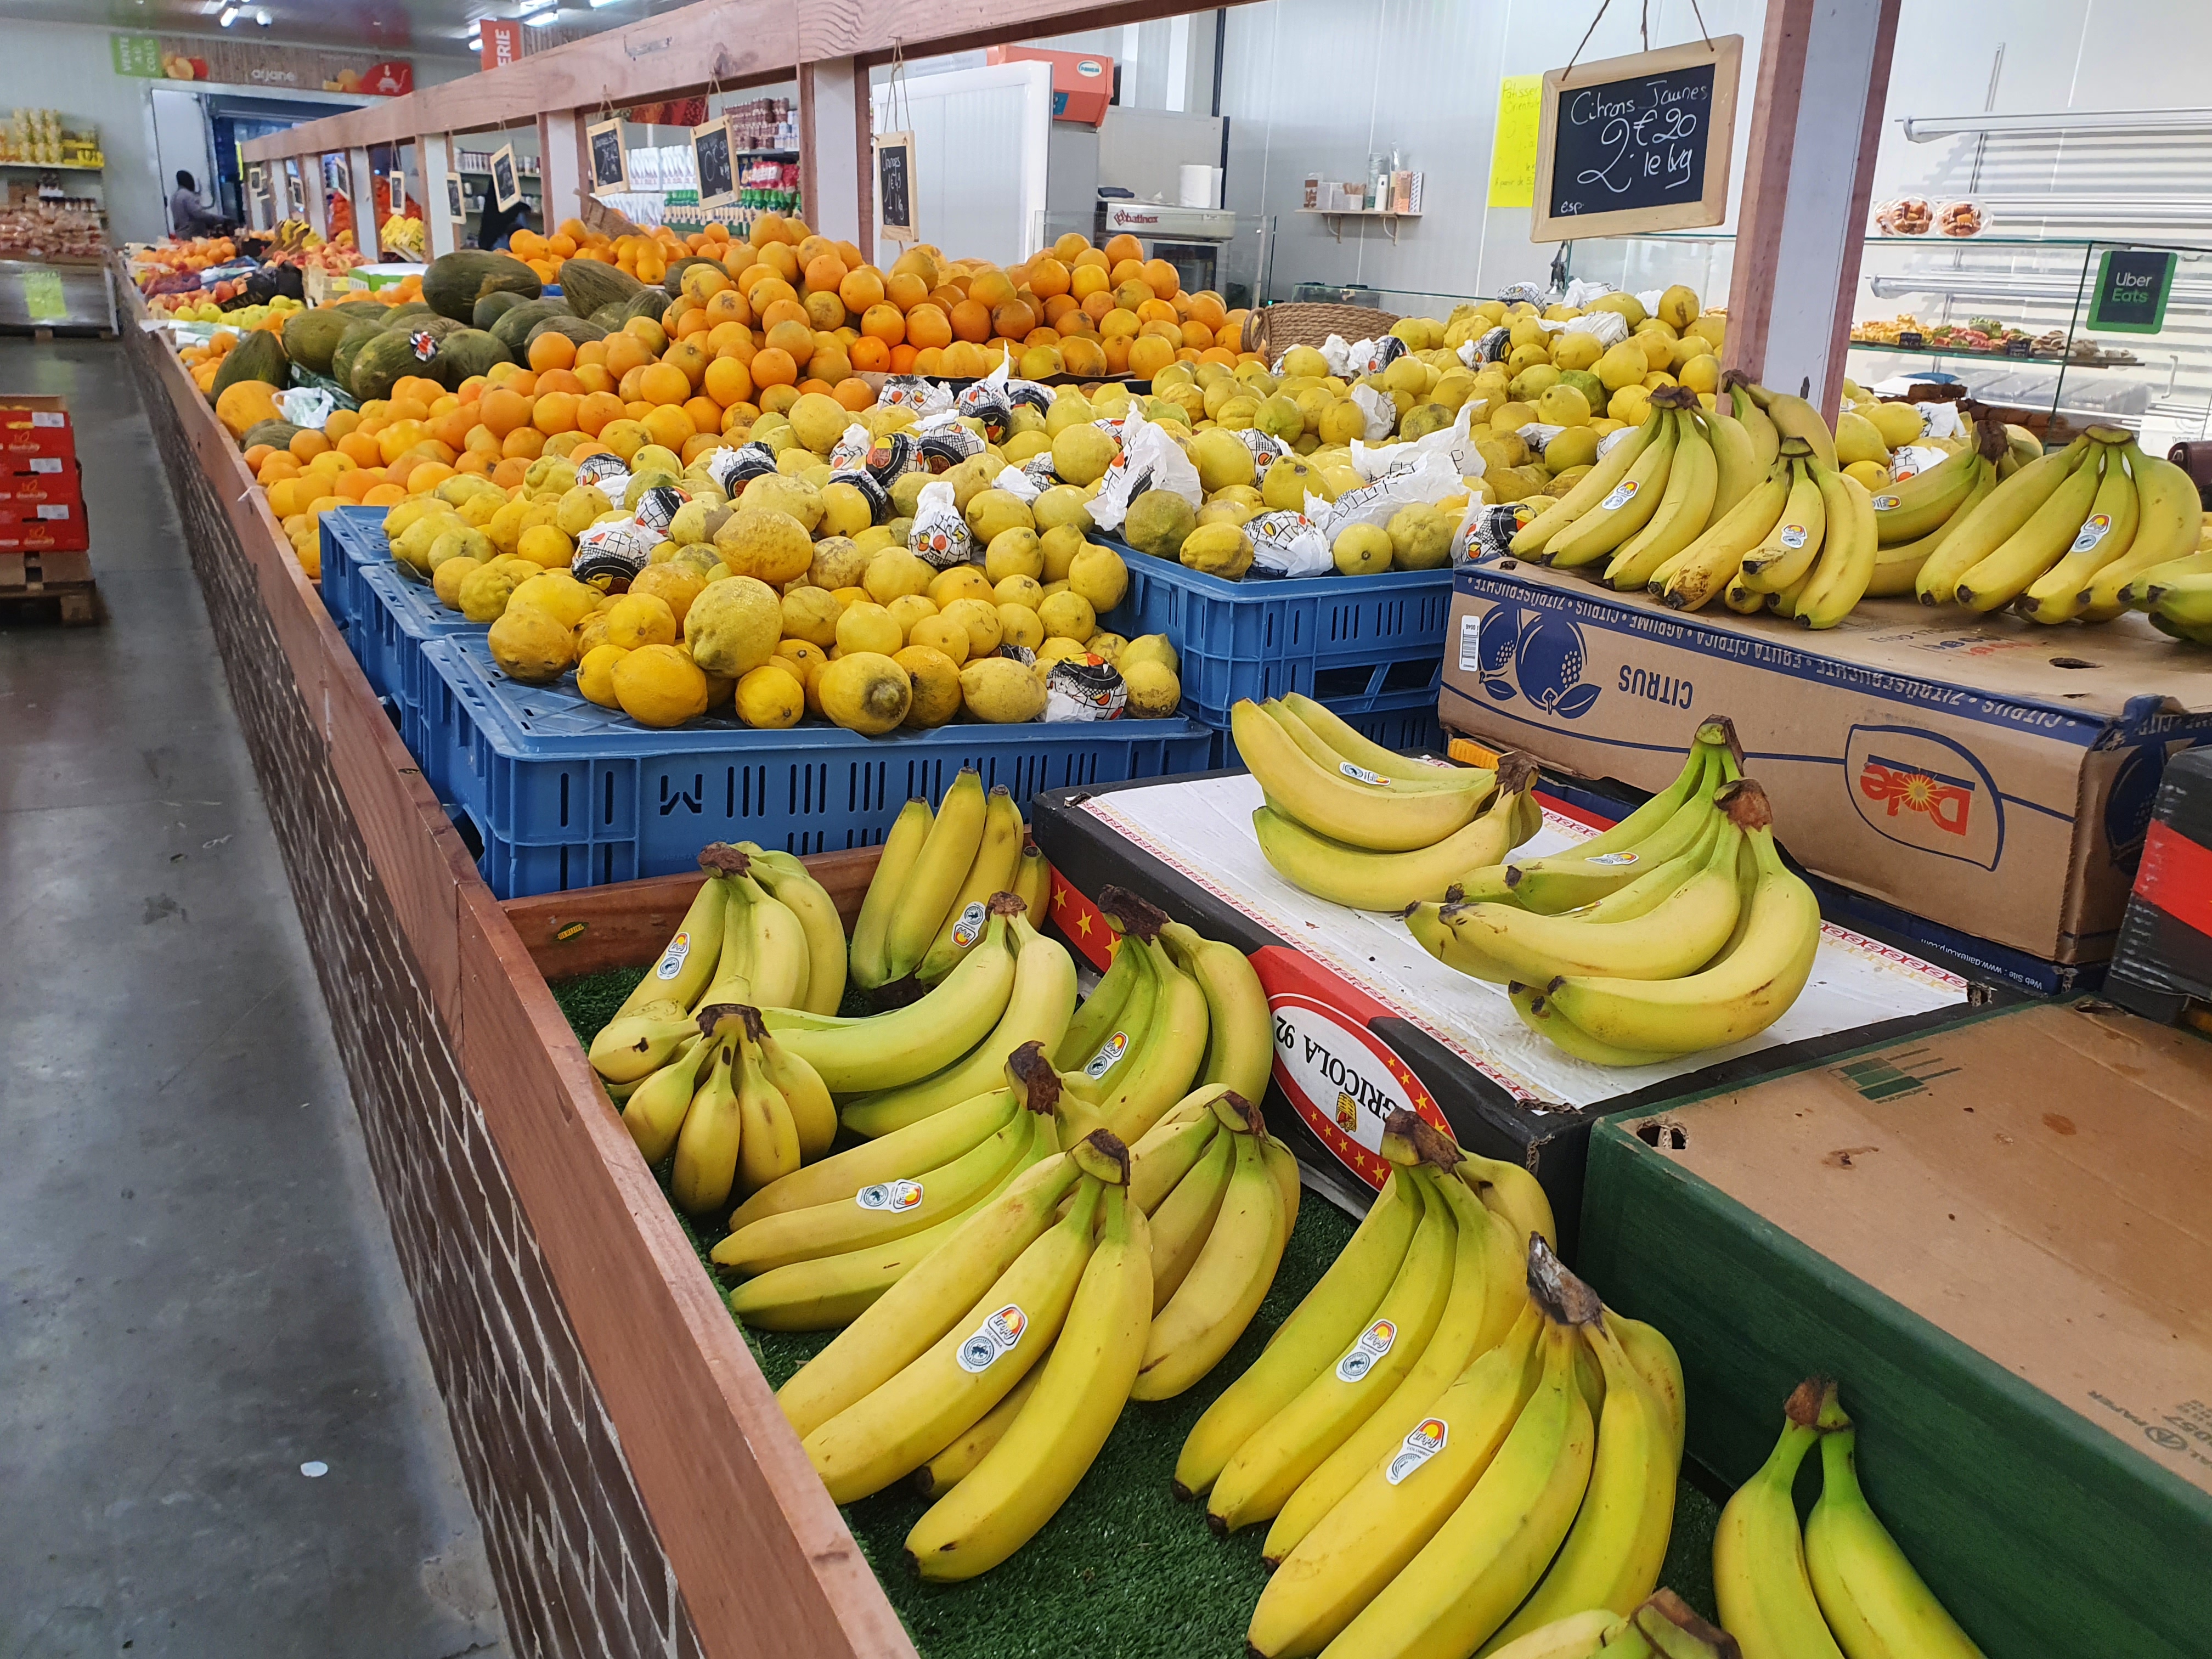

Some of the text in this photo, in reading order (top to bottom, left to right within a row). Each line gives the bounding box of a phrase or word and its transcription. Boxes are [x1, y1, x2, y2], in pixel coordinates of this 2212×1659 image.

[144, 39, 156, 72] COLIS
[1571, 80, 1708, 126] Citrons Jaunes
[2111, 287, 2149, 303] Eats
[2115, 272, 2153, 287] Uber
[1618, 664, 1694, 709] CITRUS
[1860, 764, 1971, 837] Dole
[2024, 977, 2042, 990] Web
[1276, 1015, 1295, 1049] 92
